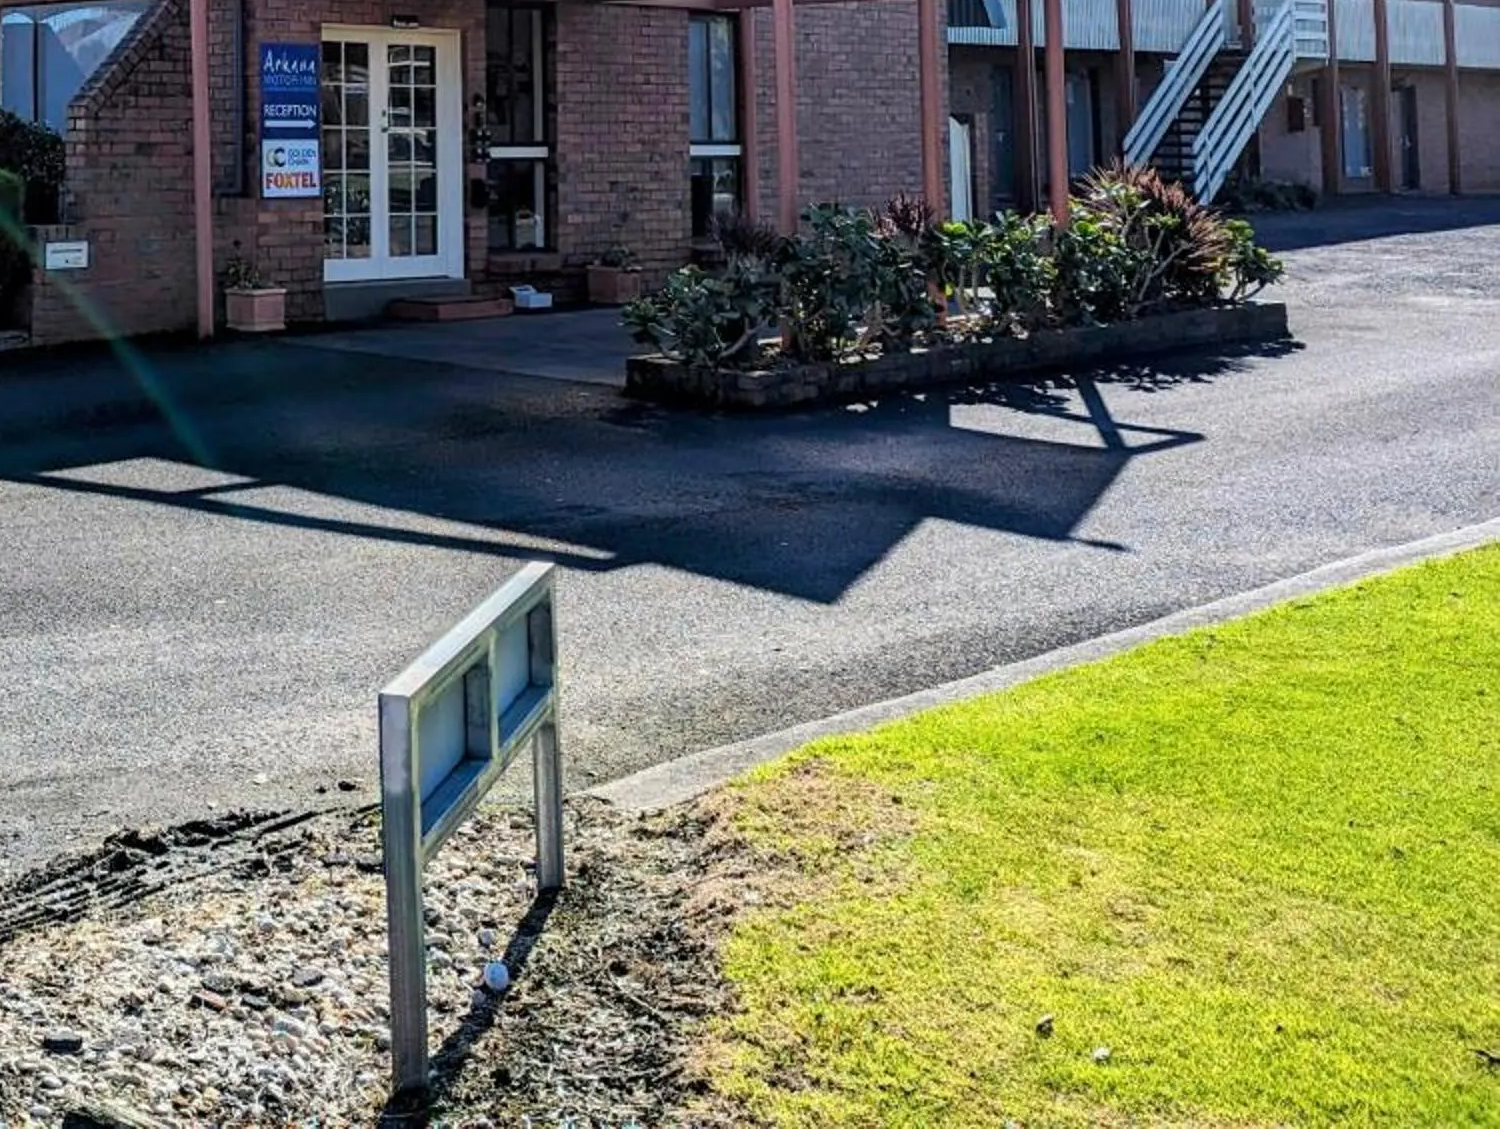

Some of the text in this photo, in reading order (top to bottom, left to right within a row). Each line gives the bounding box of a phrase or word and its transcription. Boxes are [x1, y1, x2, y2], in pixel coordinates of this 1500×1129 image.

[264, 48, 316, 73] Arkana
[264, 104, 316, 117] RECEPTION
[266, 172, 316, 189] FOXTEL
